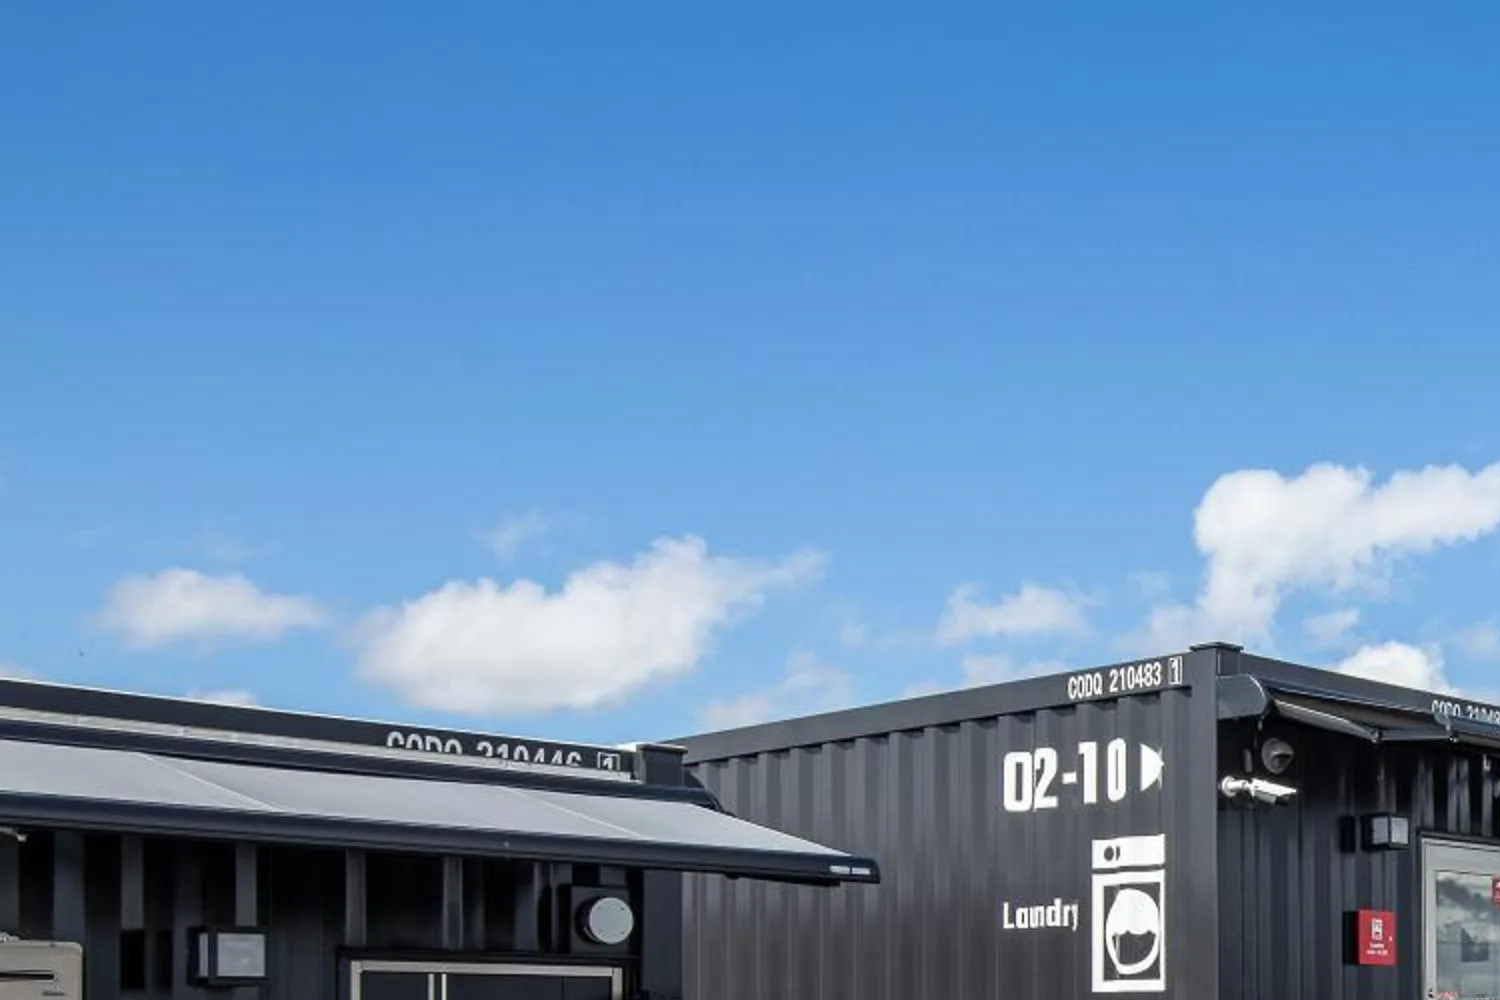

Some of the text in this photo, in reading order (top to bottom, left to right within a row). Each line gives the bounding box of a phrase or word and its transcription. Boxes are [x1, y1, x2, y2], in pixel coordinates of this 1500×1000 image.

[1067, 671, 1103, 700] CODQ
[1109, 660, 1161, 693] 210483
[1003, 737, 1127, 813] 02-10
[1002, 897, 1079, 932] Laundry
